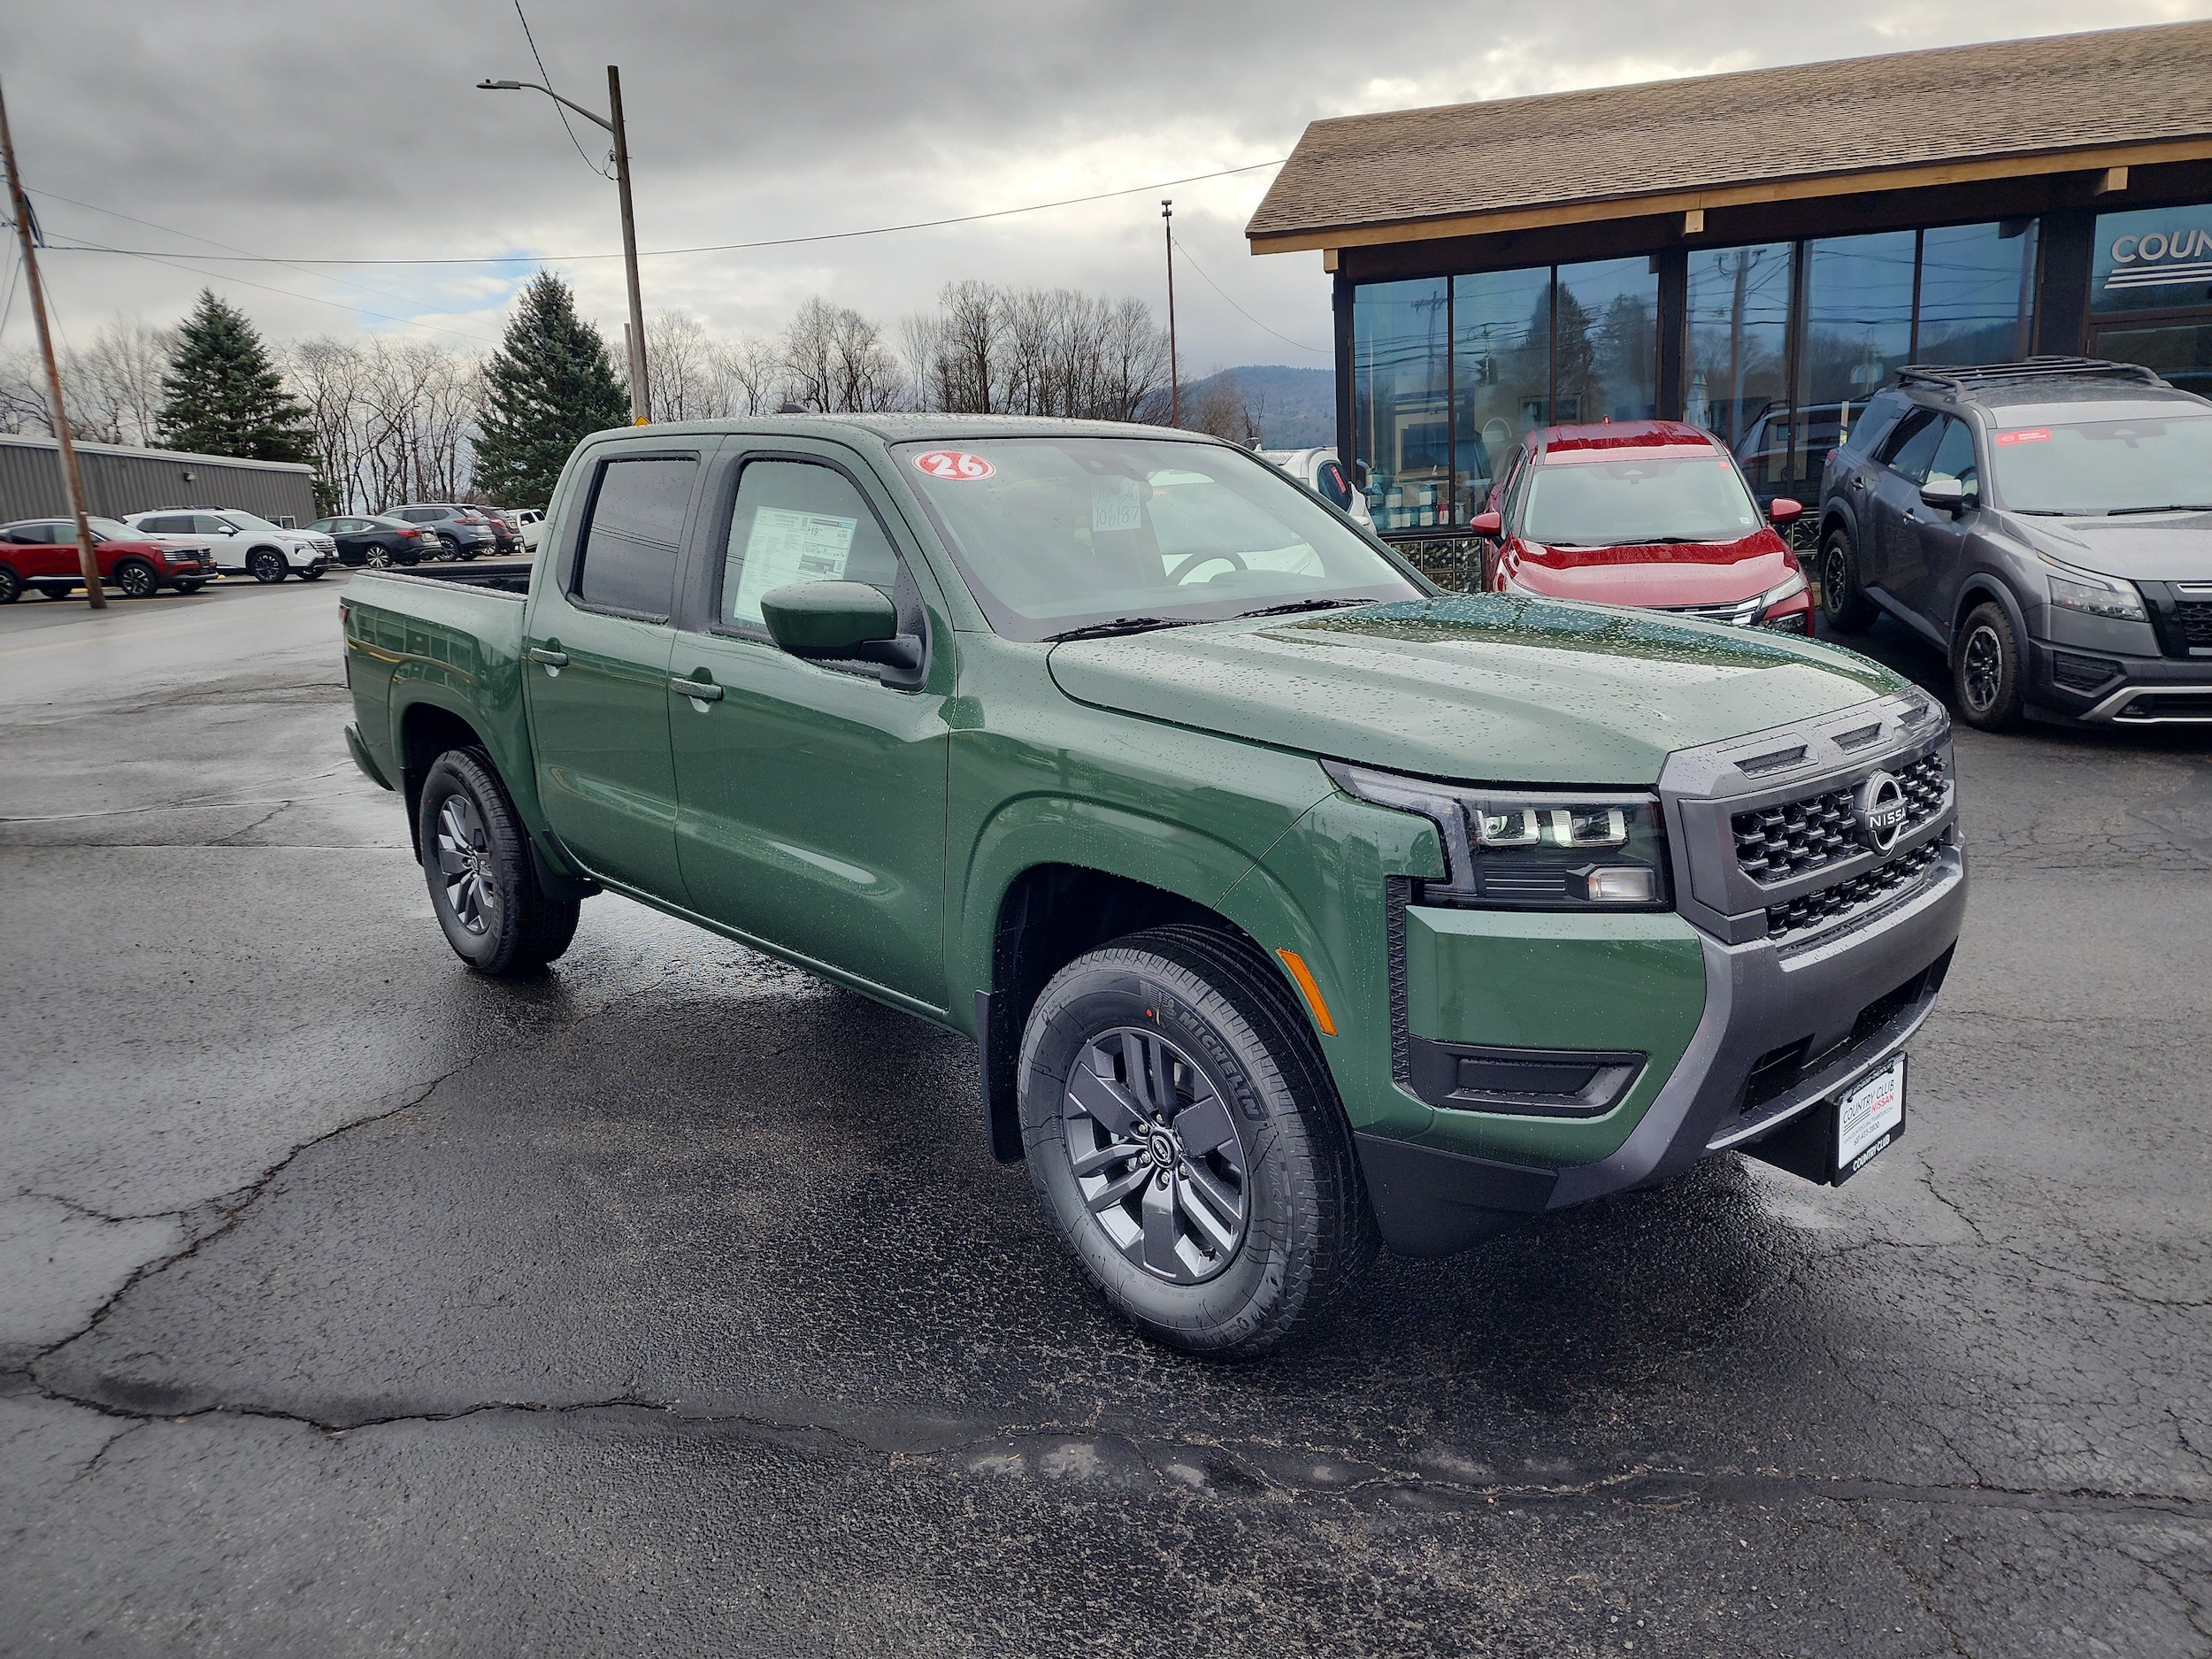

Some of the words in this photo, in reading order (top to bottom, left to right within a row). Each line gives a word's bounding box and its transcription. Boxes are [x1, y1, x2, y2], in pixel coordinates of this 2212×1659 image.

[927, 454, 983, 476] 26
[1095, 504, 1140, 528] 106187
[1178, 1010, 1261, 1116] MICHELIN
[1843, 1090, 1876, 1123] COUNTRY
[1876, 1079, 1894, 1099] CLUB
[1871, 1093, 1894, 1113] NISSAN
[1852, 1144, 1877, 1171] COUNTRY
[1876, 1133, 1890, 1152] CLUB
